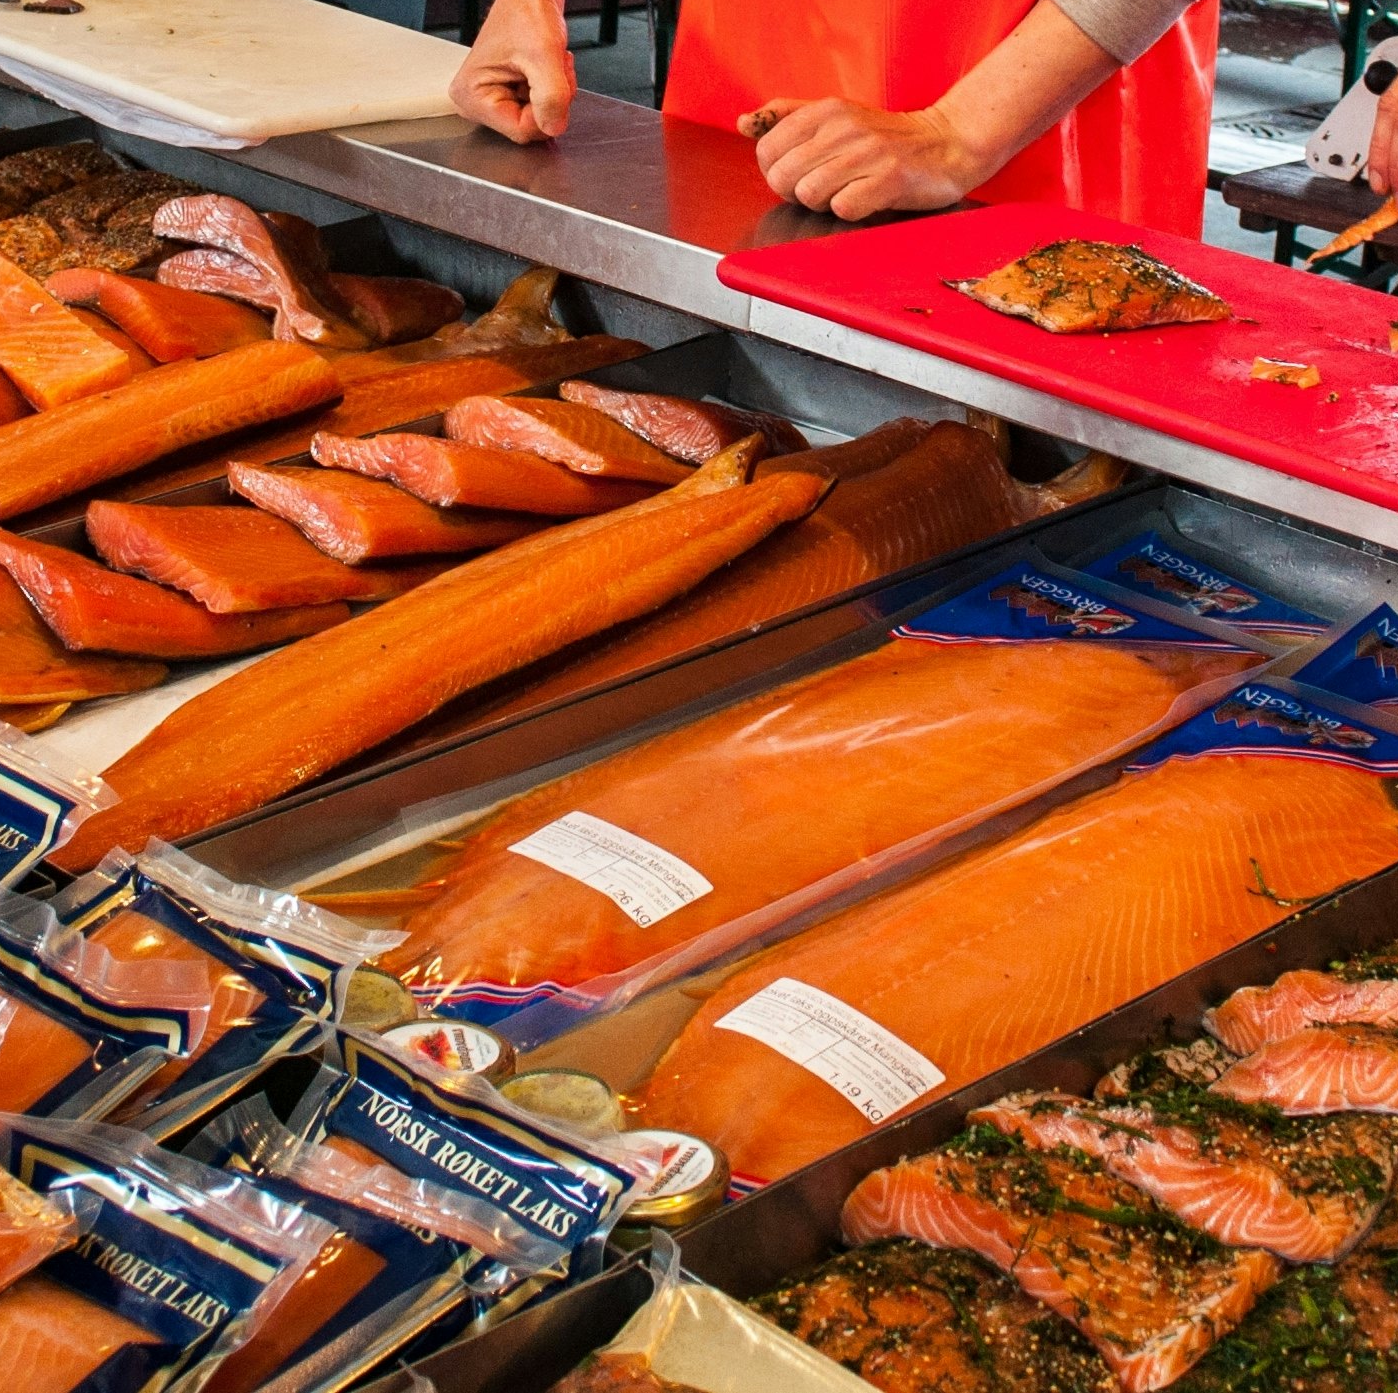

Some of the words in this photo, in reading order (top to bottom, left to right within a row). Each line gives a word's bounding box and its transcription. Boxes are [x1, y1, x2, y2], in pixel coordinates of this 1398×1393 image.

[1140, 543, 1231, 592] BRYGGEN
[1021, 573, 1107, 615] BRYGGEN
[632, 904, 652, 926] kg
[827, 1070, 862, 1098] 1.19
[861, 1098, 884, 1123] kg
[357, 1091, 441, 1157] NORSK
[430, 1138, 518, 1201] RØKET
[507, 1183, 578, 1238] LAKS
[162, 1281, 231, 1331] LAKS
